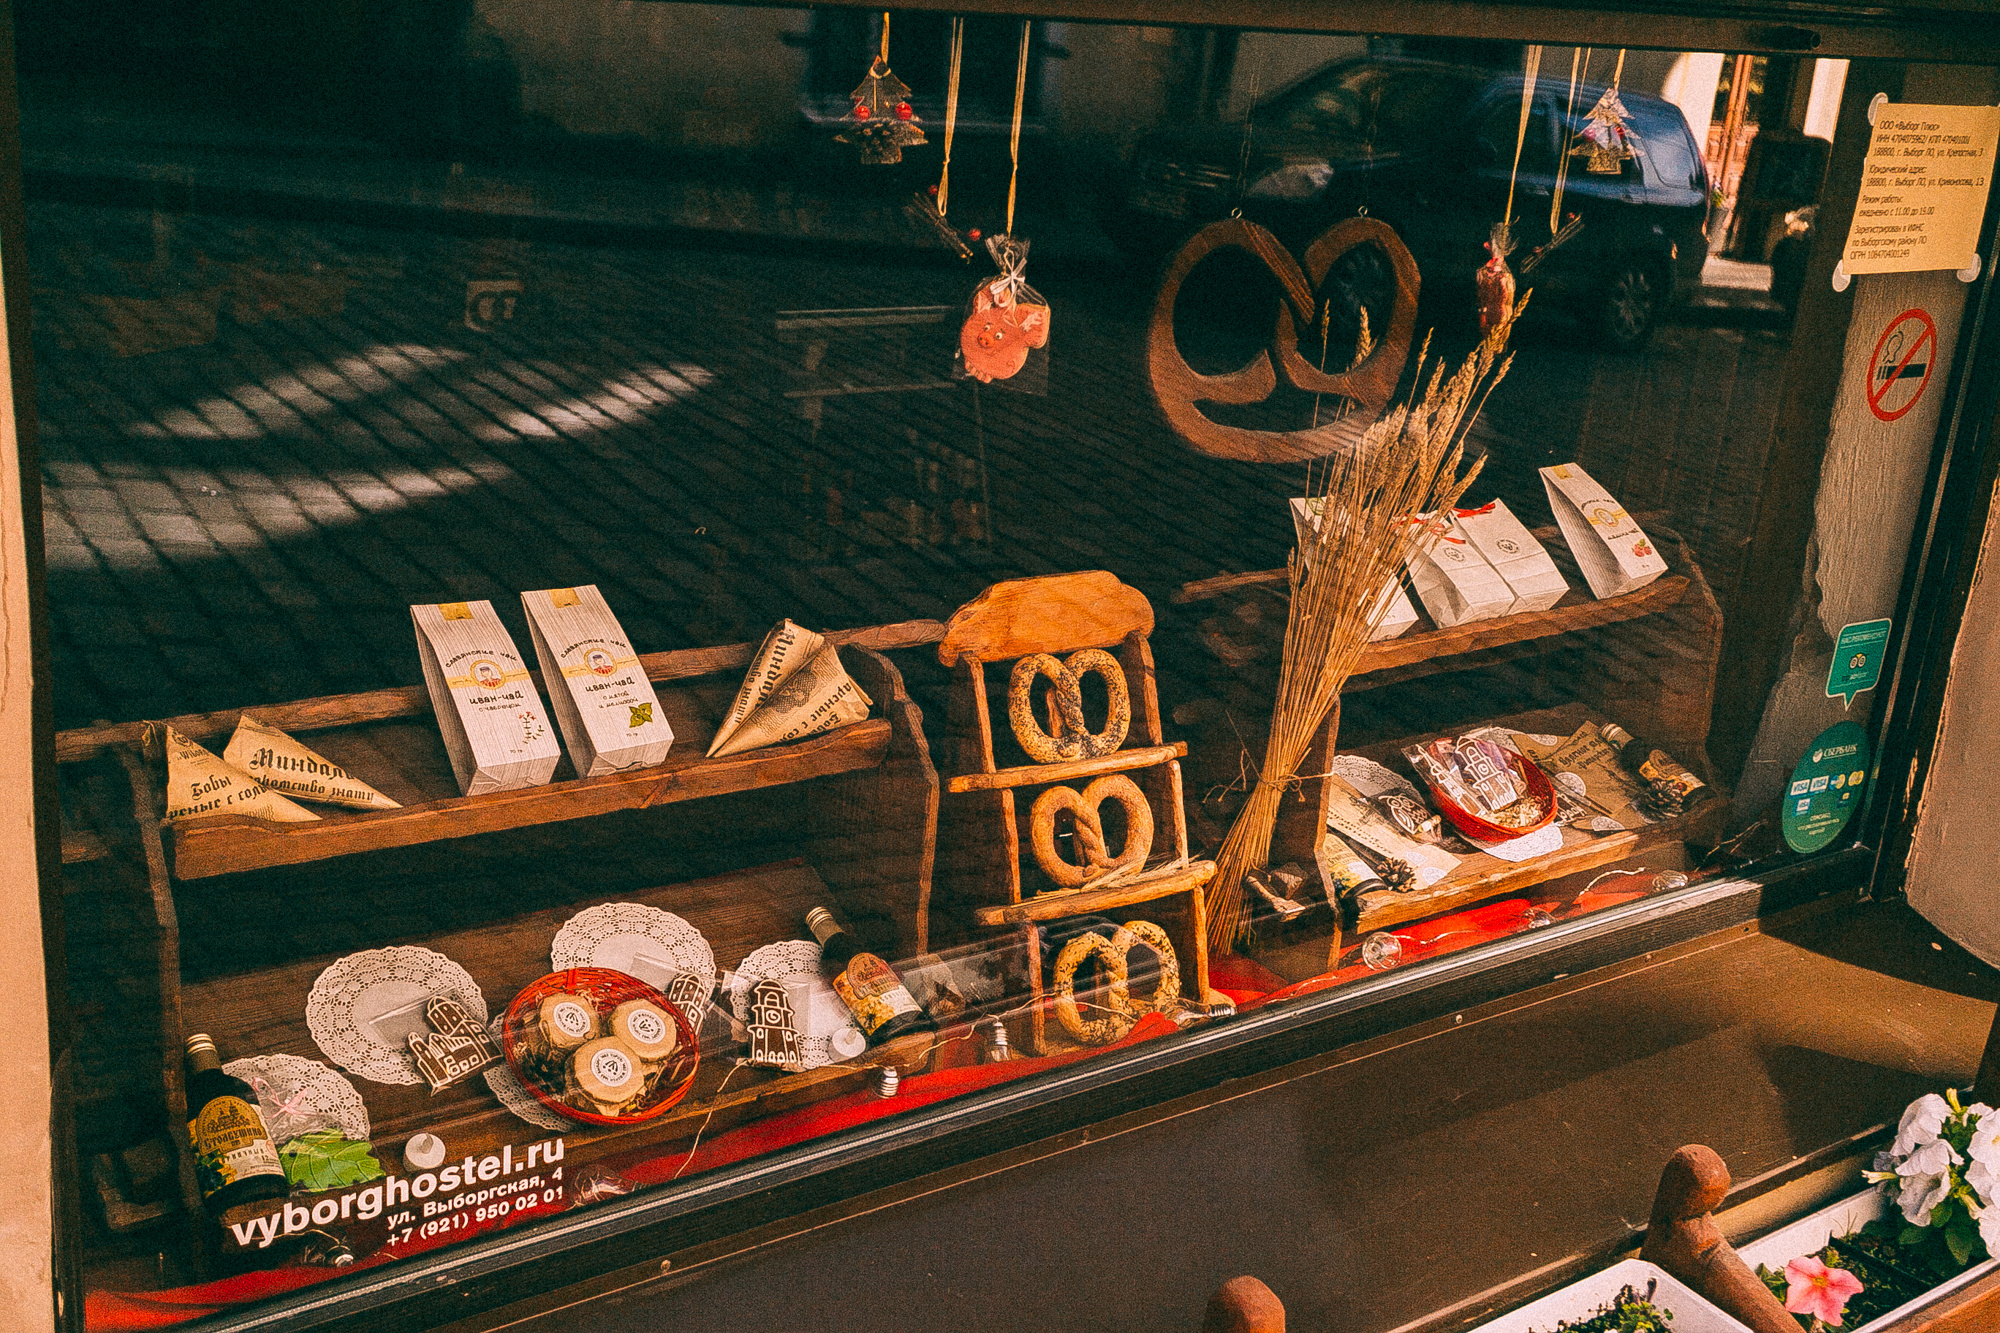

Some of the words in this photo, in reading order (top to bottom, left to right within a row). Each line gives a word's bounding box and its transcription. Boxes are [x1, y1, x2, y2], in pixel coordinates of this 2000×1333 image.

[1879, 121, 1894, 130] ООО
[1876, 134, 1890, 144] ИНН
[1928, 135, 1941, 145] КПП
[1903, 147, 1924, 158] Выборг
[1936, 149, 1945, 158] ул.
[1978, 148, 1984, 157] 3
[1869, 164, 1908, 174] Юридический
[1895, 177, 1915, 187] Выборг
[1927, 178, 1936, 188] ул.
[1975, 177, 1985, 186] 13
[1862, 194, 1881, 204] Режим
[1859, 209, 1889, 217] ежедневно
[1894, 207, 1911, 216] 11.00
[1910, 208, 1918, 217] до
[1854, 224, 1902, 235] Зарегистрирован
[1907, 222, 1924, 232] ИФНС
[1852, 239, 1860, 247] по
[1860, 236, 1897, 248] Выборгскому
[1897, 235, 1918, 247] району
[1918, 235, 1928, 245] ЛО
[1850, 250, 1866, 260] ОГРН
[561, 638, 605, 659] славянские
[610, 639, 627, 648] чаи
[445, 649, 494, 668] славянские
[500, 651, 518, 661] чаи
[756, 628, 795, 708] Миндал
[585, 676, 635, 692] иван-чай
[469, 690, 525, 705] иван-чай
[1823, 743, 1858, 757] СБЕРБАНК
[191, 774, 232, 799] Бобы
[249, 774, 326, 794] акомство
[331, 786, 375, 801] знати
[226, 793, 234, 805] с
[230, 1137, 565, 1249] vyborghostel.ru
[387, 1211, 416, 1231] ул.
[423, 1175, 546, 1218] Выборгская,
[552, 1166, 563, 1181] 4
[386, 1227, 413, 1247] +7
[419, 1212, 469, 1240] (921)
[475, 1201, 510, 1222] 950
[515, 1193, 538, 1211] 02
[543, 1186, 563, 1203] 01
